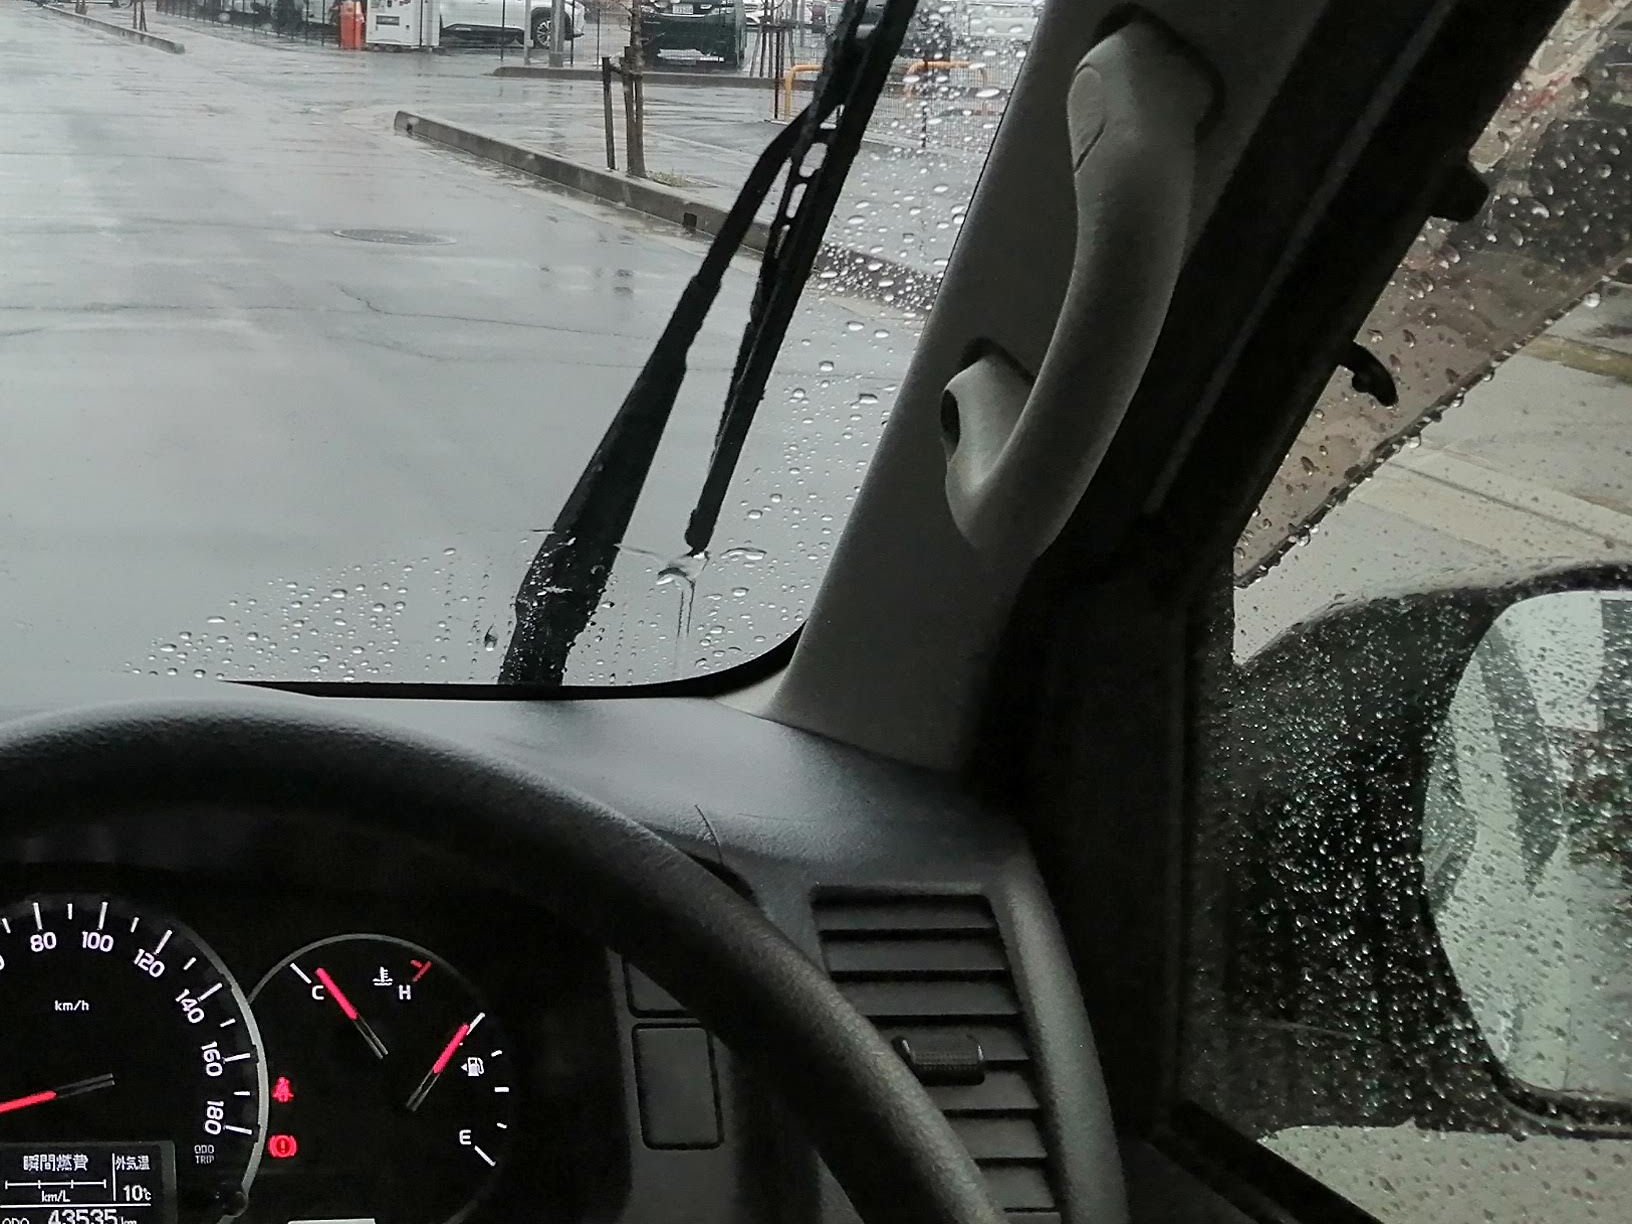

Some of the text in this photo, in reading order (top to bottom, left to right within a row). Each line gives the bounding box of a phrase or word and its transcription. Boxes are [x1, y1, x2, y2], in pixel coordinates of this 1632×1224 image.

[30, 931, 57, 952] 80
[82, 931, 114, 952] 100
[132, 949, 165, 978] 120
[312, 985, 324, 1000] C
[399, 985, 411, 1000] H
[54, 999, 90, 1012] km/h
[175, 989, 205, 1024] 140
[201, 1041, 223, 1077] 160
[204, 1100, 224, 1135] 180
[459, 1130, 471, 1145] E
[194, 1144, 215, 1154] ODO
[23, 1154, 88, 1171] 瞬間燃費
[116, 1155, 150, 1170] 外気温
[195, 1154, 215, 1164] TRIP
[41, 1190, 71, 1202] km/L
